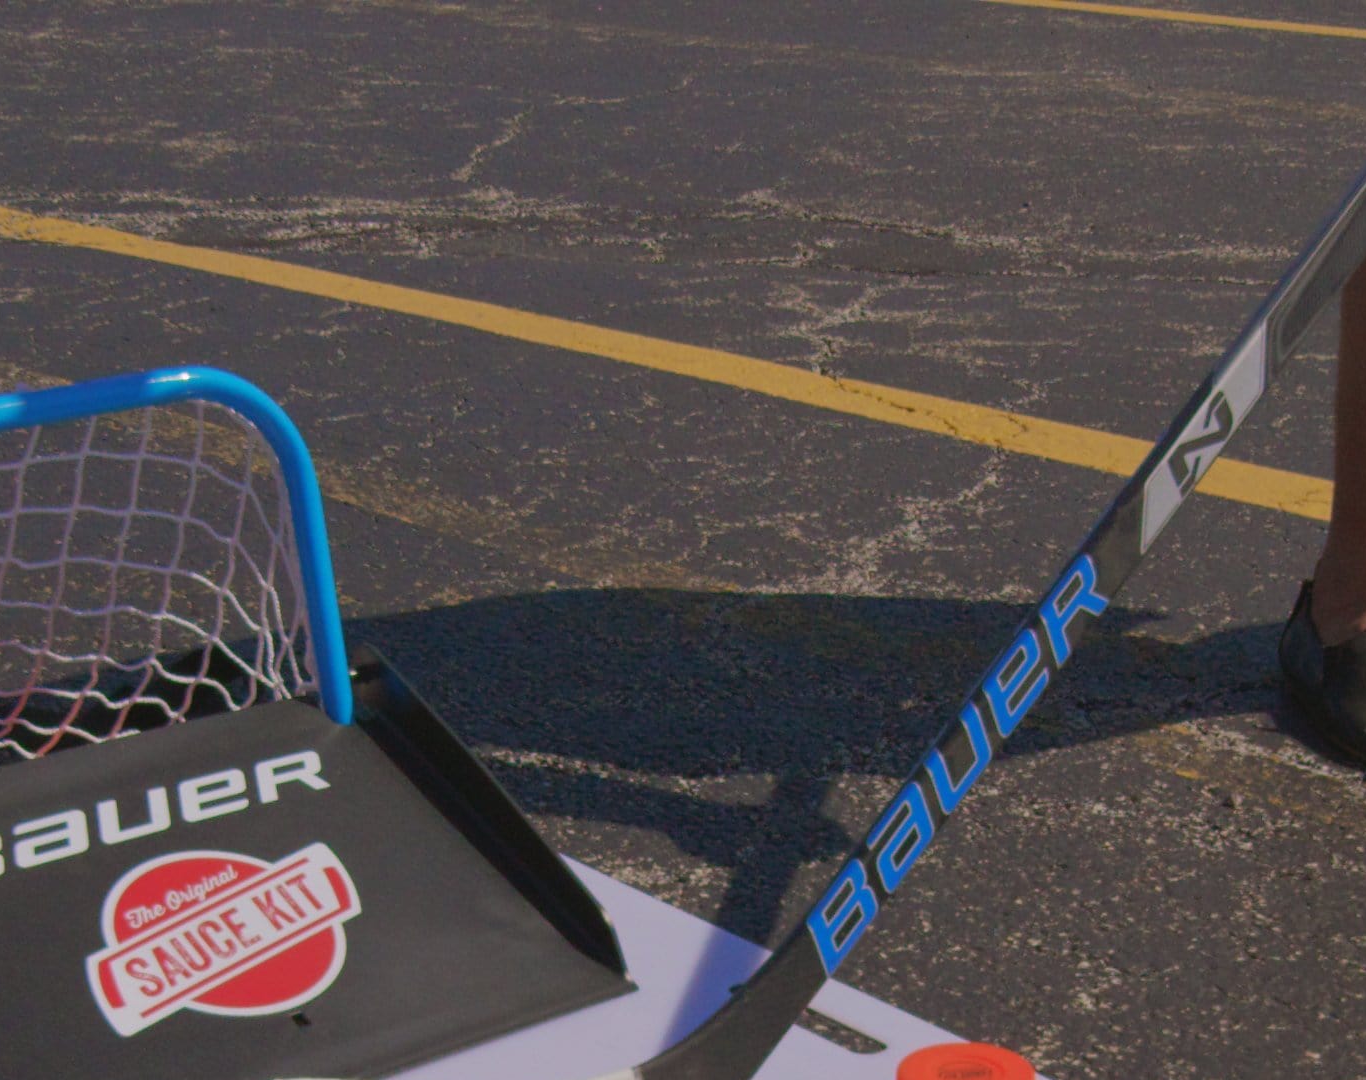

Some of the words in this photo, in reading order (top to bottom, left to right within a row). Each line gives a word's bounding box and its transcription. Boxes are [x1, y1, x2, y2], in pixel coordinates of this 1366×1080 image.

[125, 904, 166, 929] The
[165, 864, 239, 909] Original
[125, 908, 262, 997] SAUCE
[251, 873, 323, 931] KIT
